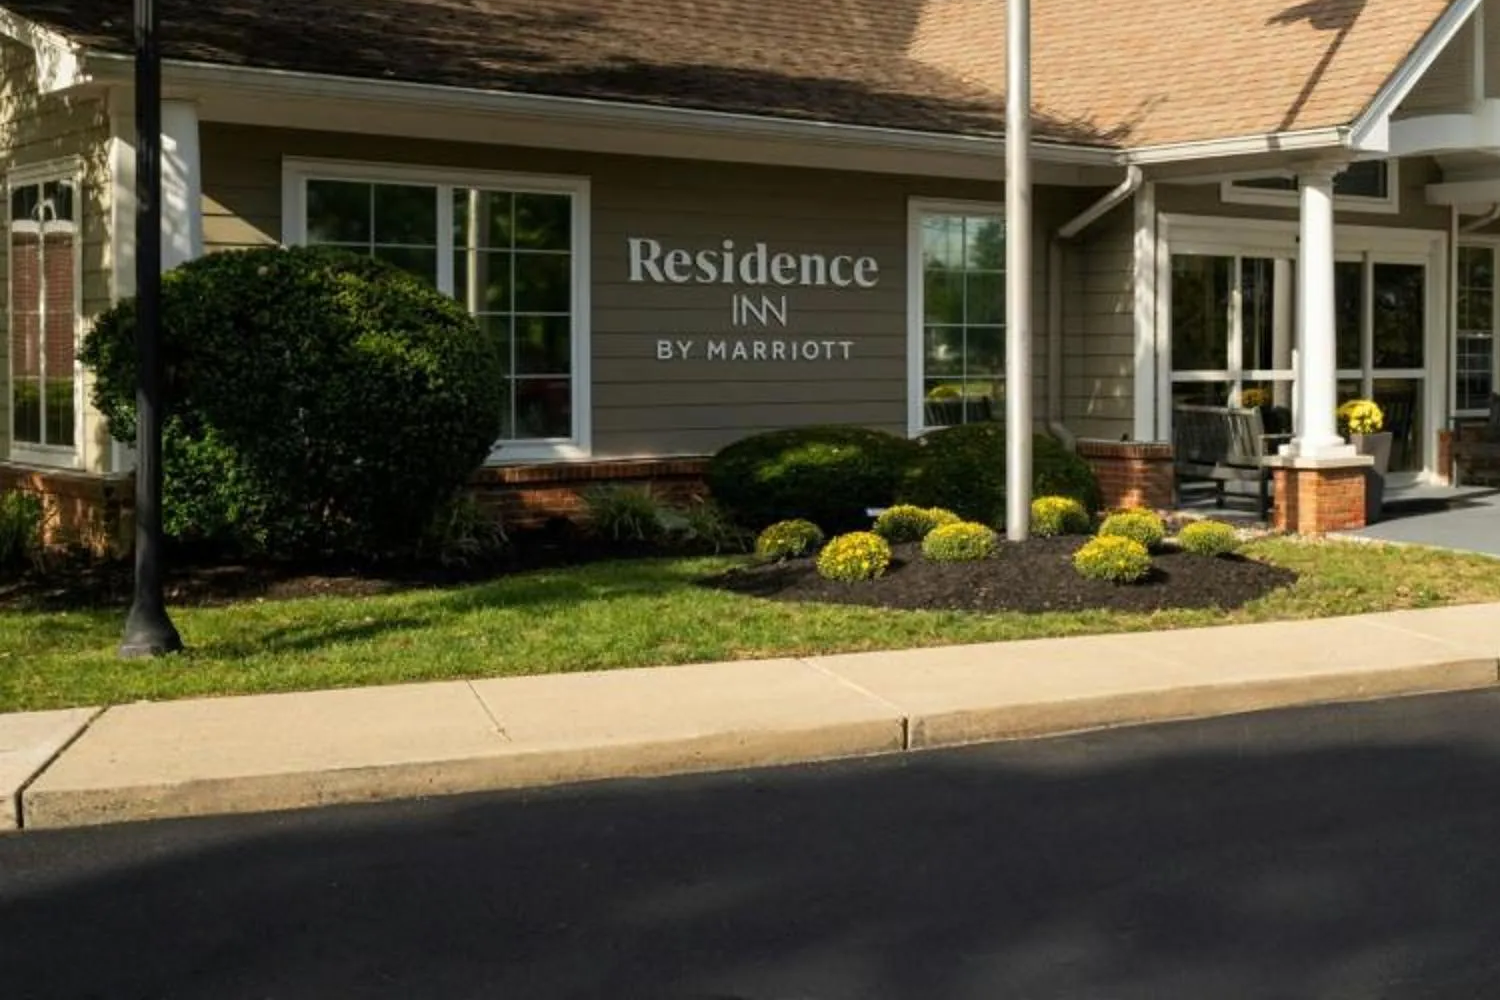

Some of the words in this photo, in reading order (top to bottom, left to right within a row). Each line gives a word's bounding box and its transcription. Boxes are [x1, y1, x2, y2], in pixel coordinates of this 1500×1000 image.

[628, 237, 879, 287] Residence
[732, 294, 787, 326] INN
[657, 340, 693, 360] BY
[707, 340, 855, 360] MARRIOTT
